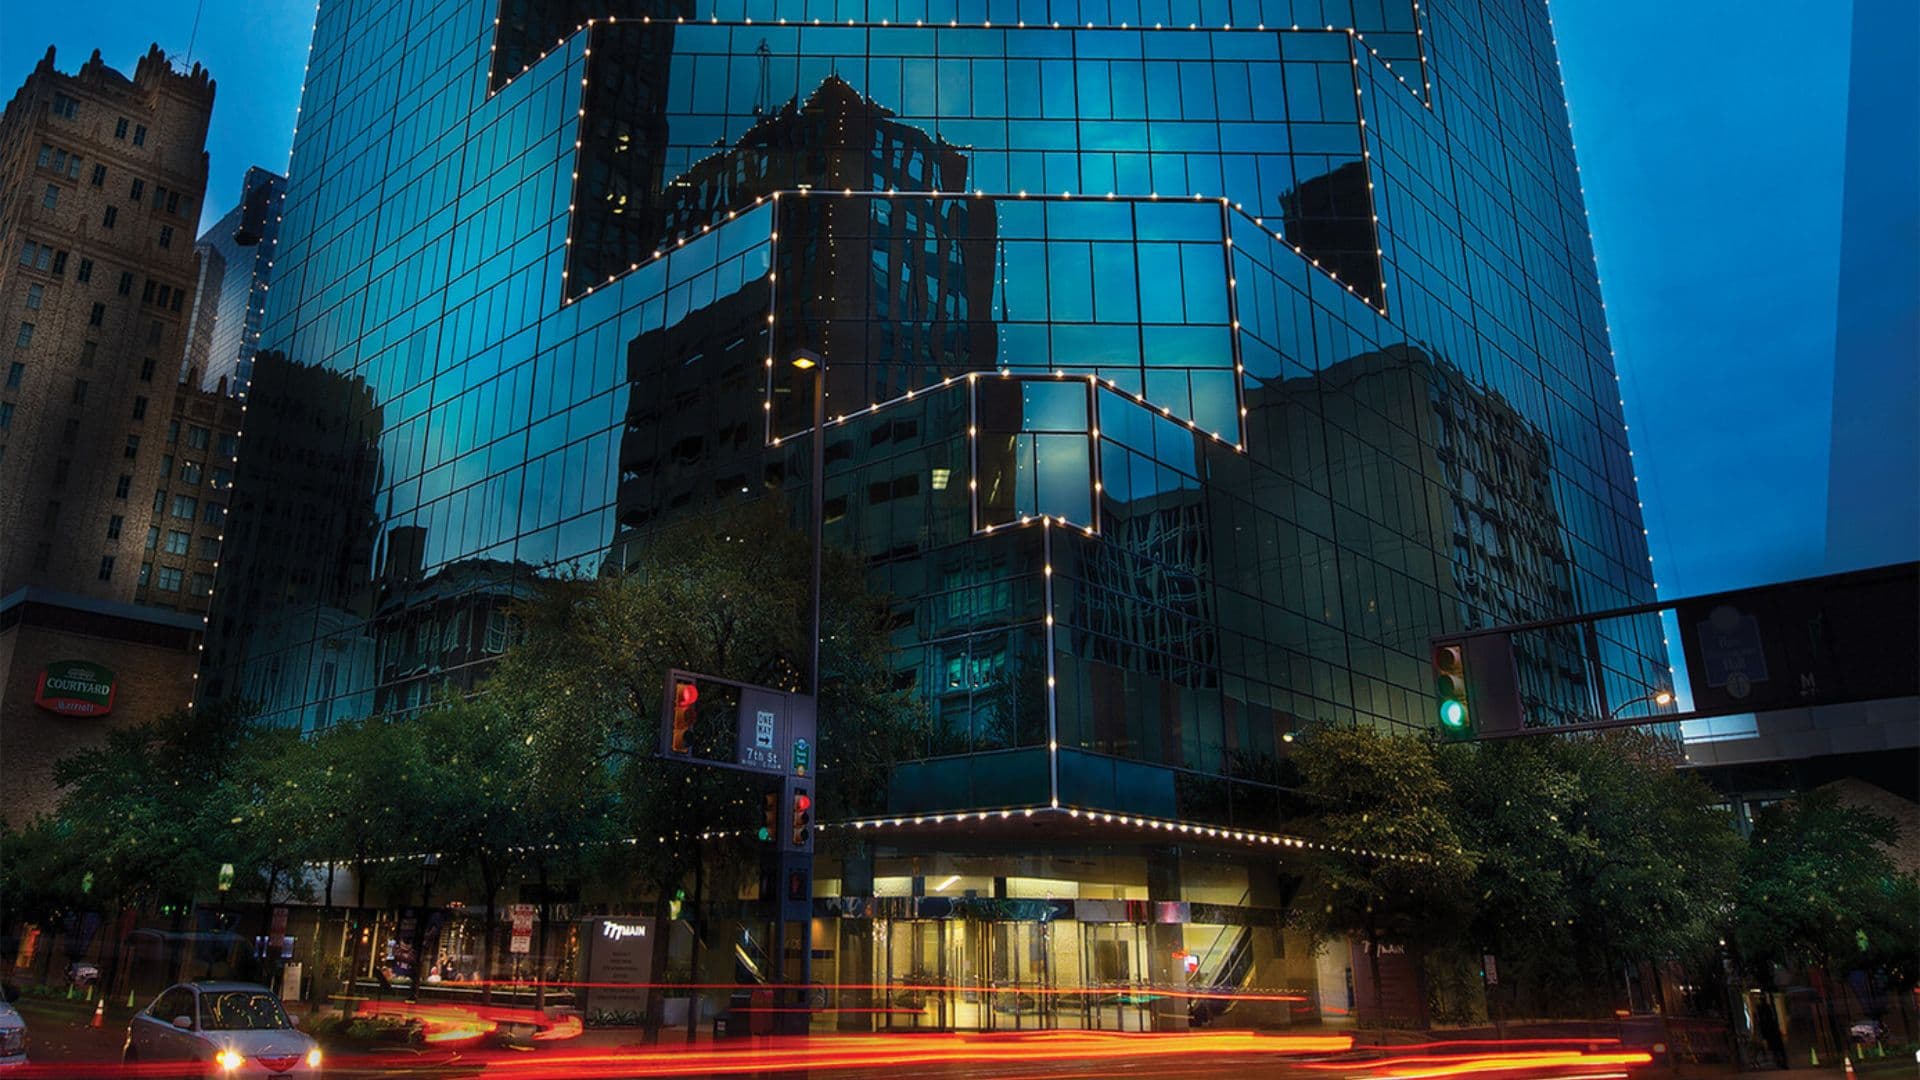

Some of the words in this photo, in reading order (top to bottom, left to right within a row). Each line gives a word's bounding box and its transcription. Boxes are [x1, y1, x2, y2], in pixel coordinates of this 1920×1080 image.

[47, 678, 110, 695] COURTYARD
[758, 713, 774, 727] ONE
[758, 725, 773, 737] WAY
[746, 747, 764, 761] 7th
[767, 752, 777, 764] St
